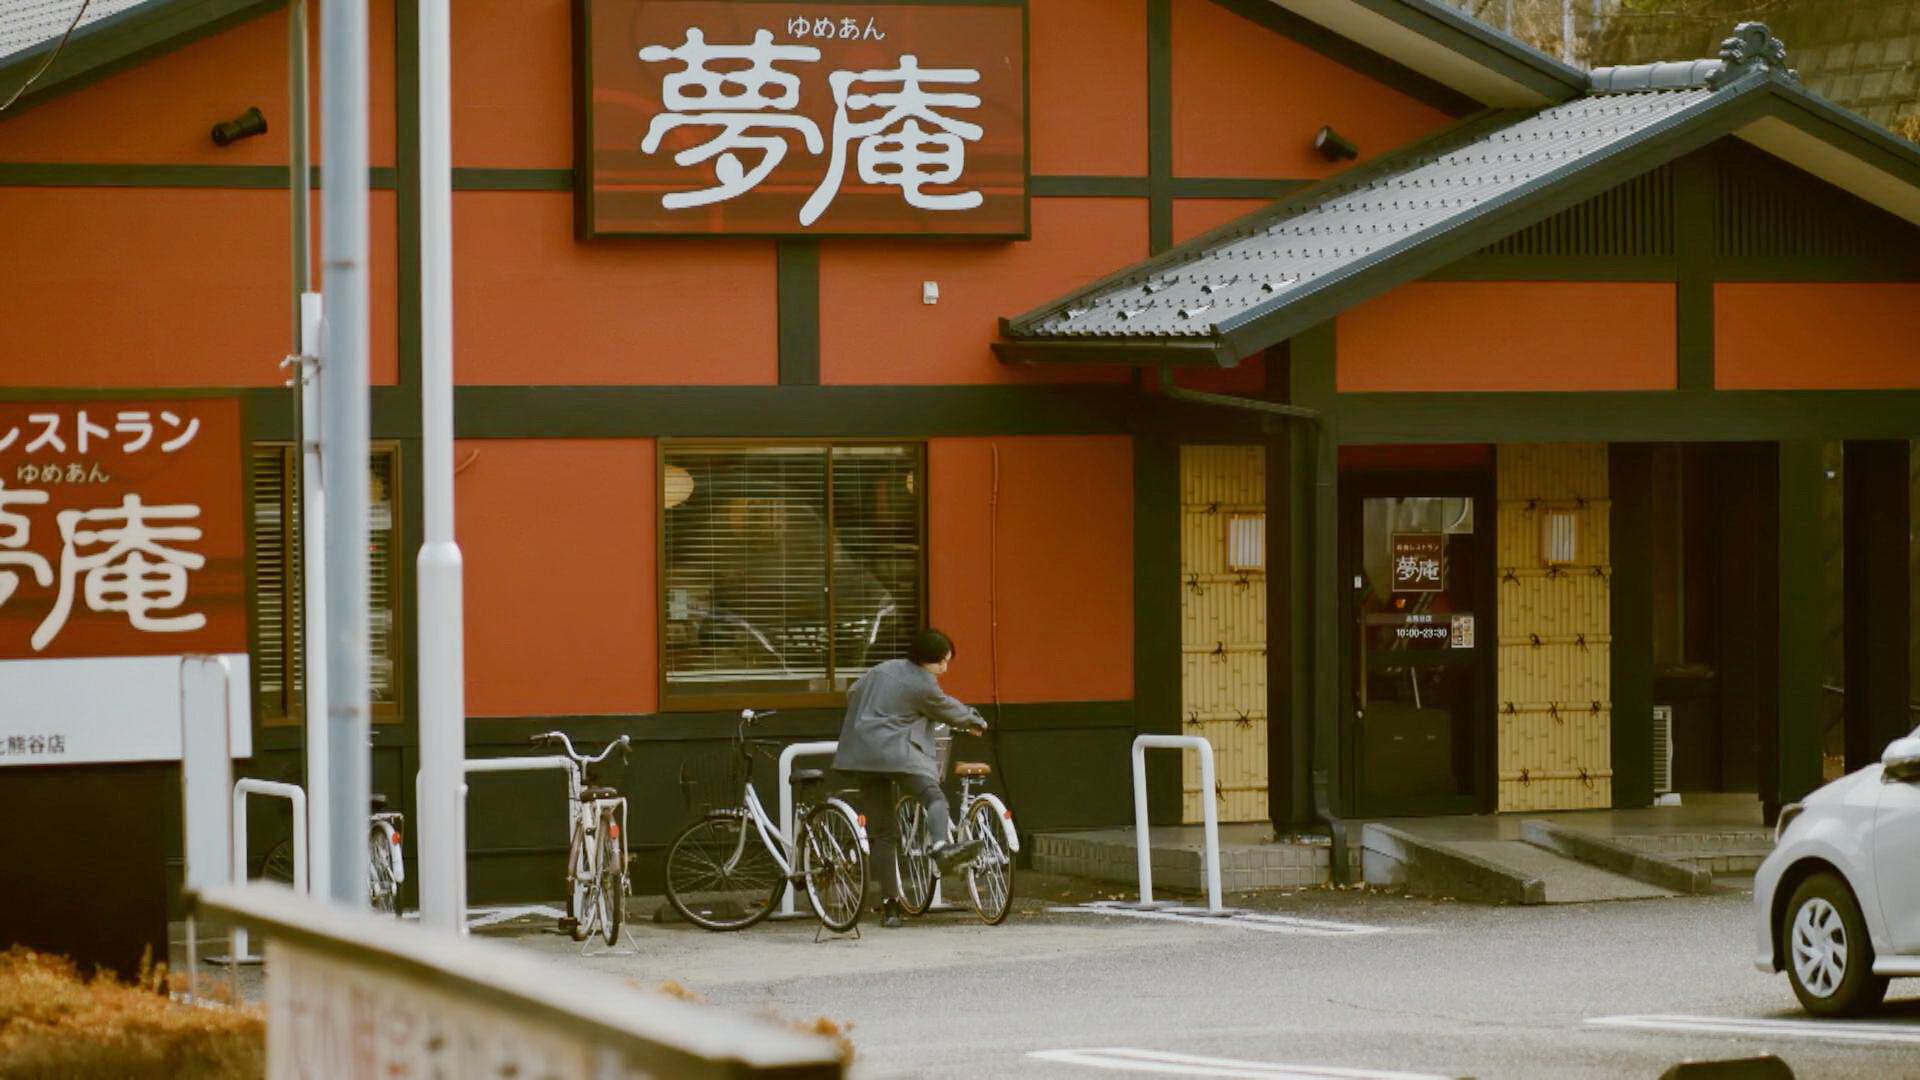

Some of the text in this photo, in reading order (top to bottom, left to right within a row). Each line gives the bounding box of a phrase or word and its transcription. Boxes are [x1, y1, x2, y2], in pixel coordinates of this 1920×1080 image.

[787, 16, 886, 41] ゆめあん
[638, 27, 984, 227] 夢庵
[16, 463, 110, 484] ゆめあん
[1395, 556, 1440, 582] 夢庵
